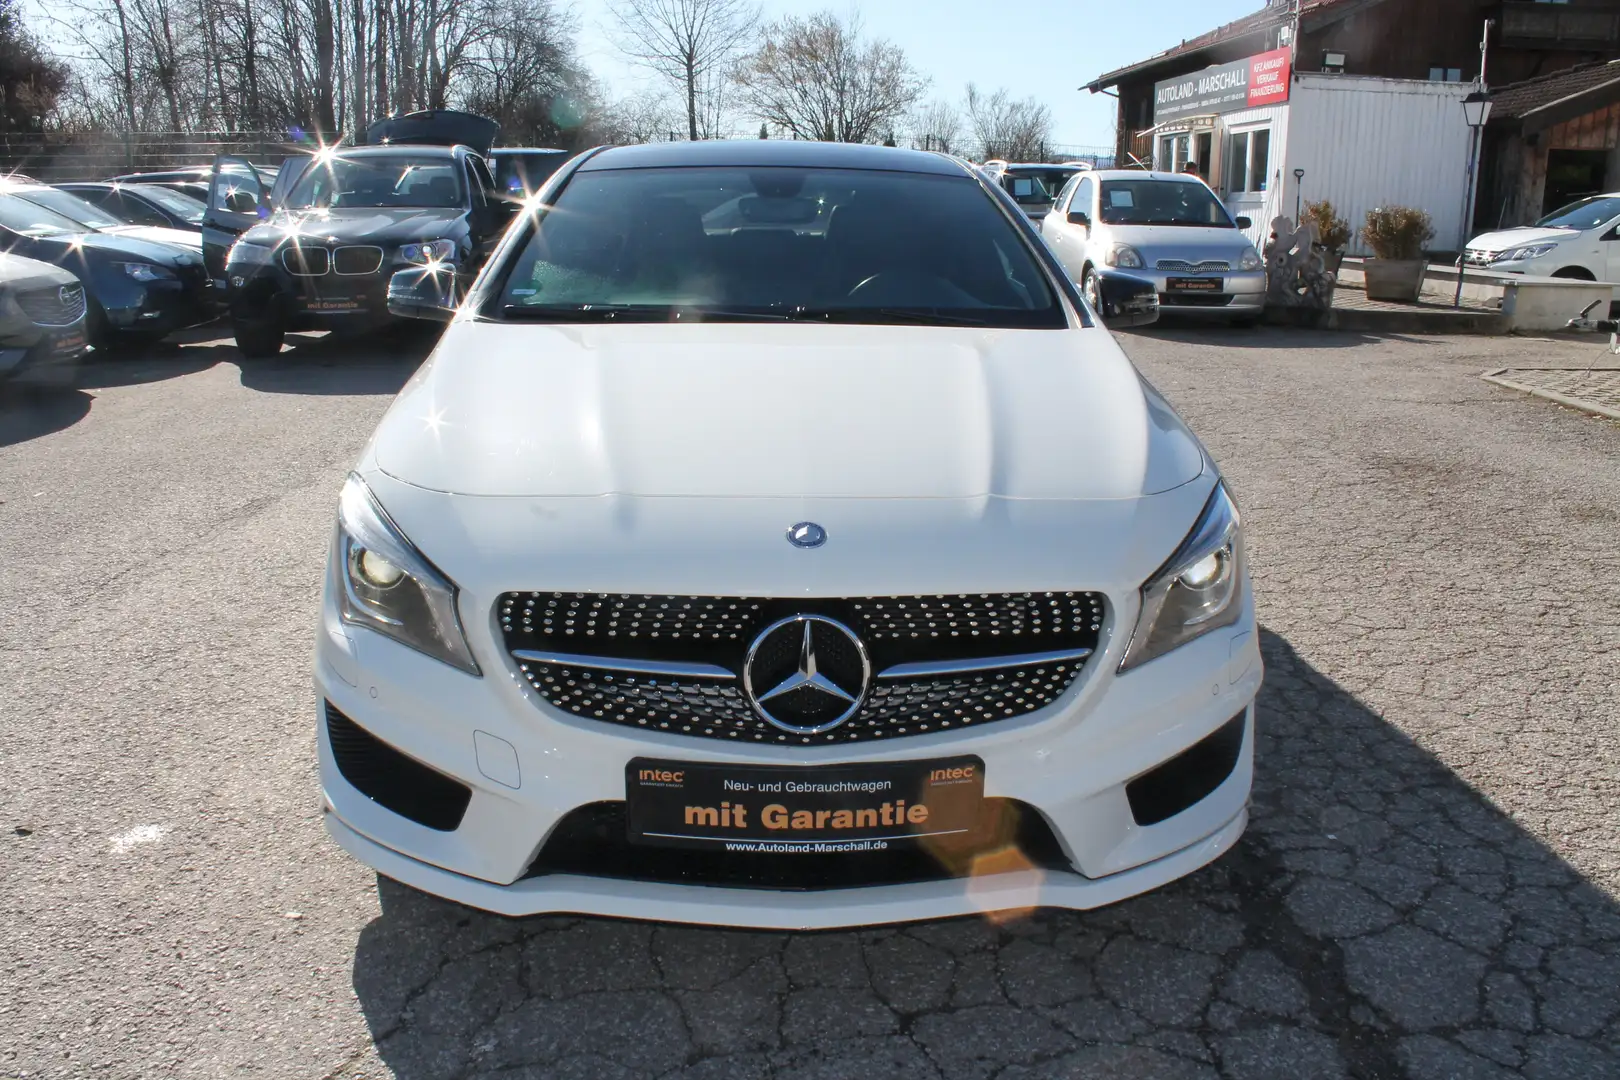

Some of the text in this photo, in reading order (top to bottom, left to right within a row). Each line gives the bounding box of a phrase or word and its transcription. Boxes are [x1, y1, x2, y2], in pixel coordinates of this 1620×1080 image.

[1256, 68, 1279, 84] VERKAUF
[1157, 84, 1193, 104] AUTOLAND
[1198, 69, 1246, 94] MARSCHALL
[1250, 82, 1285, 98] FINANZIERUNG
[639, 769, 684, 782] intec
[930, 766, 974, 781] intec
[724, 779, 892, 793] Neu- und Gebrauchtwagen
[684, 799, 929, 830] mit Garantie
[725, 841, 888, 853] www.Autoland-Marschall.de
